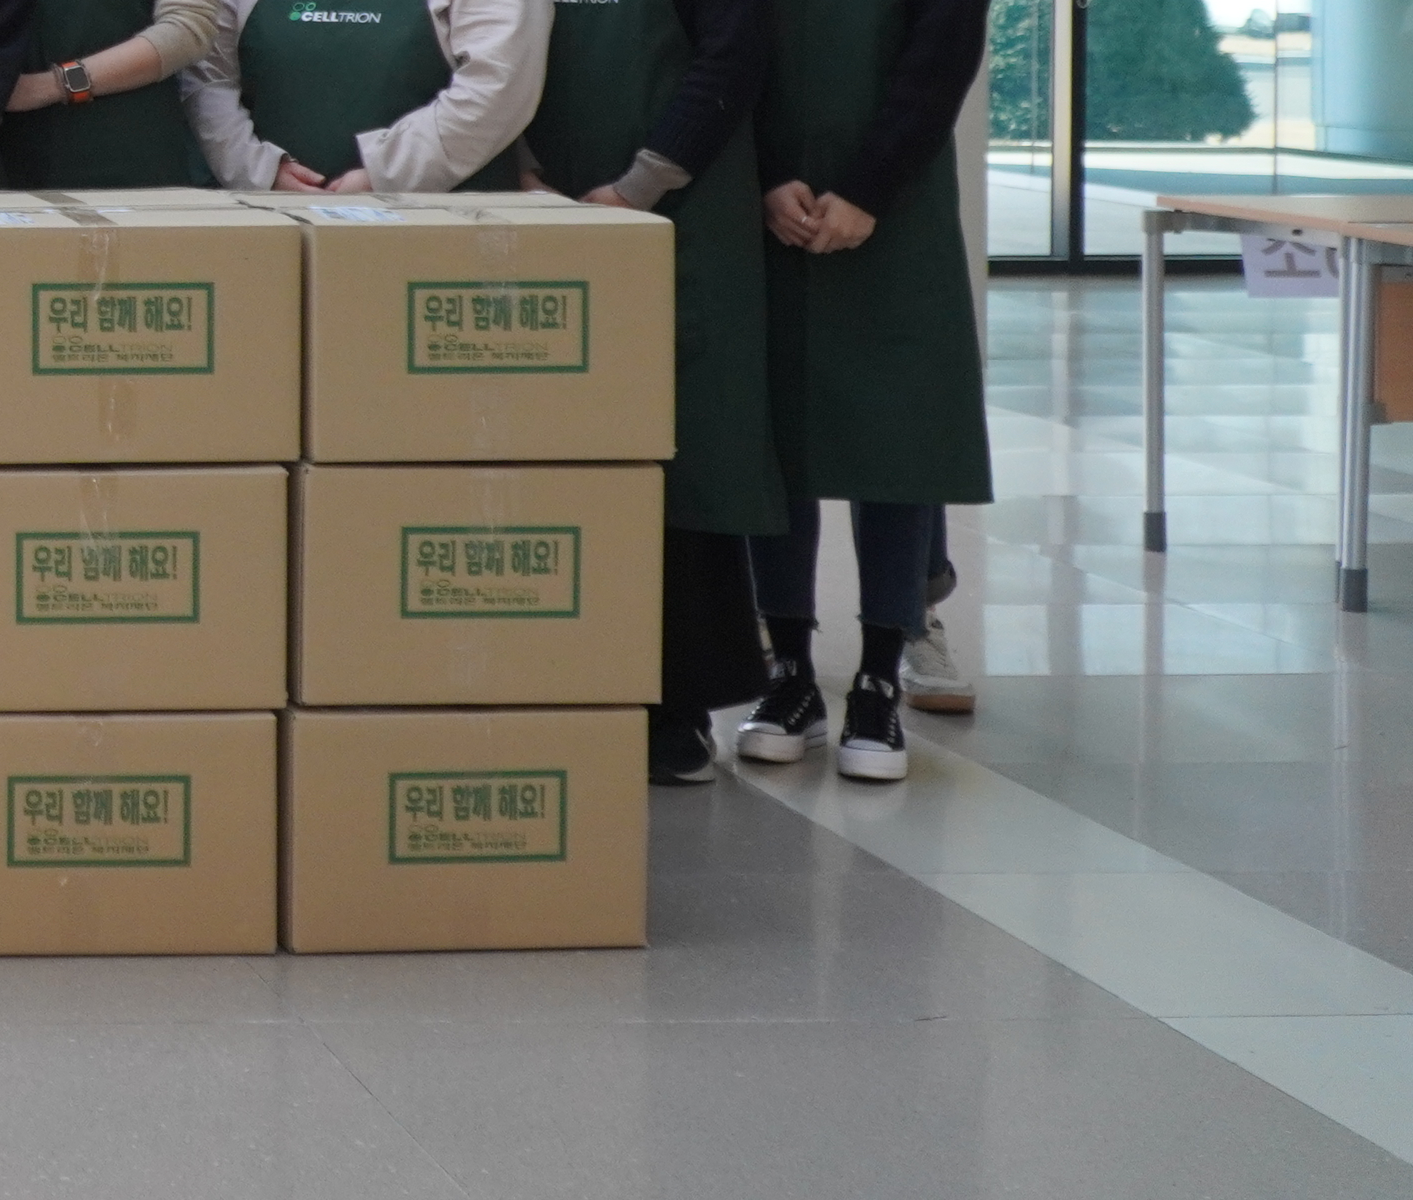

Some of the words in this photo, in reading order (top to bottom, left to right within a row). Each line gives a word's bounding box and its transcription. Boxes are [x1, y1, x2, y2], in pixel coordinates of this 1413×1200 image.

[300, 11, 382, 24] CELLTRION
[47, 296, 86, 333] 우리
[95, 296, 135, 333] 함께
[142, 296, 191, 333] 해요!
[423, 294, 462, 332] 우리
[517, 294, 566, 332] 해요!
[31, 546, 70, 582] 우리
[127, 546, 176, 582] 해요!
[416, 540, 454, 576] 우리
[509, 540, 557, 576] 해요!
[23, 788, 62, 824] 우리
[71, 788, 112, 824] 함께
[119, 788, 168, 824] 해요!
[404, 783, 442, 821] 우리
[451, 783, 491, 821] 함께
[497, 783, 545, 821] 해요!
